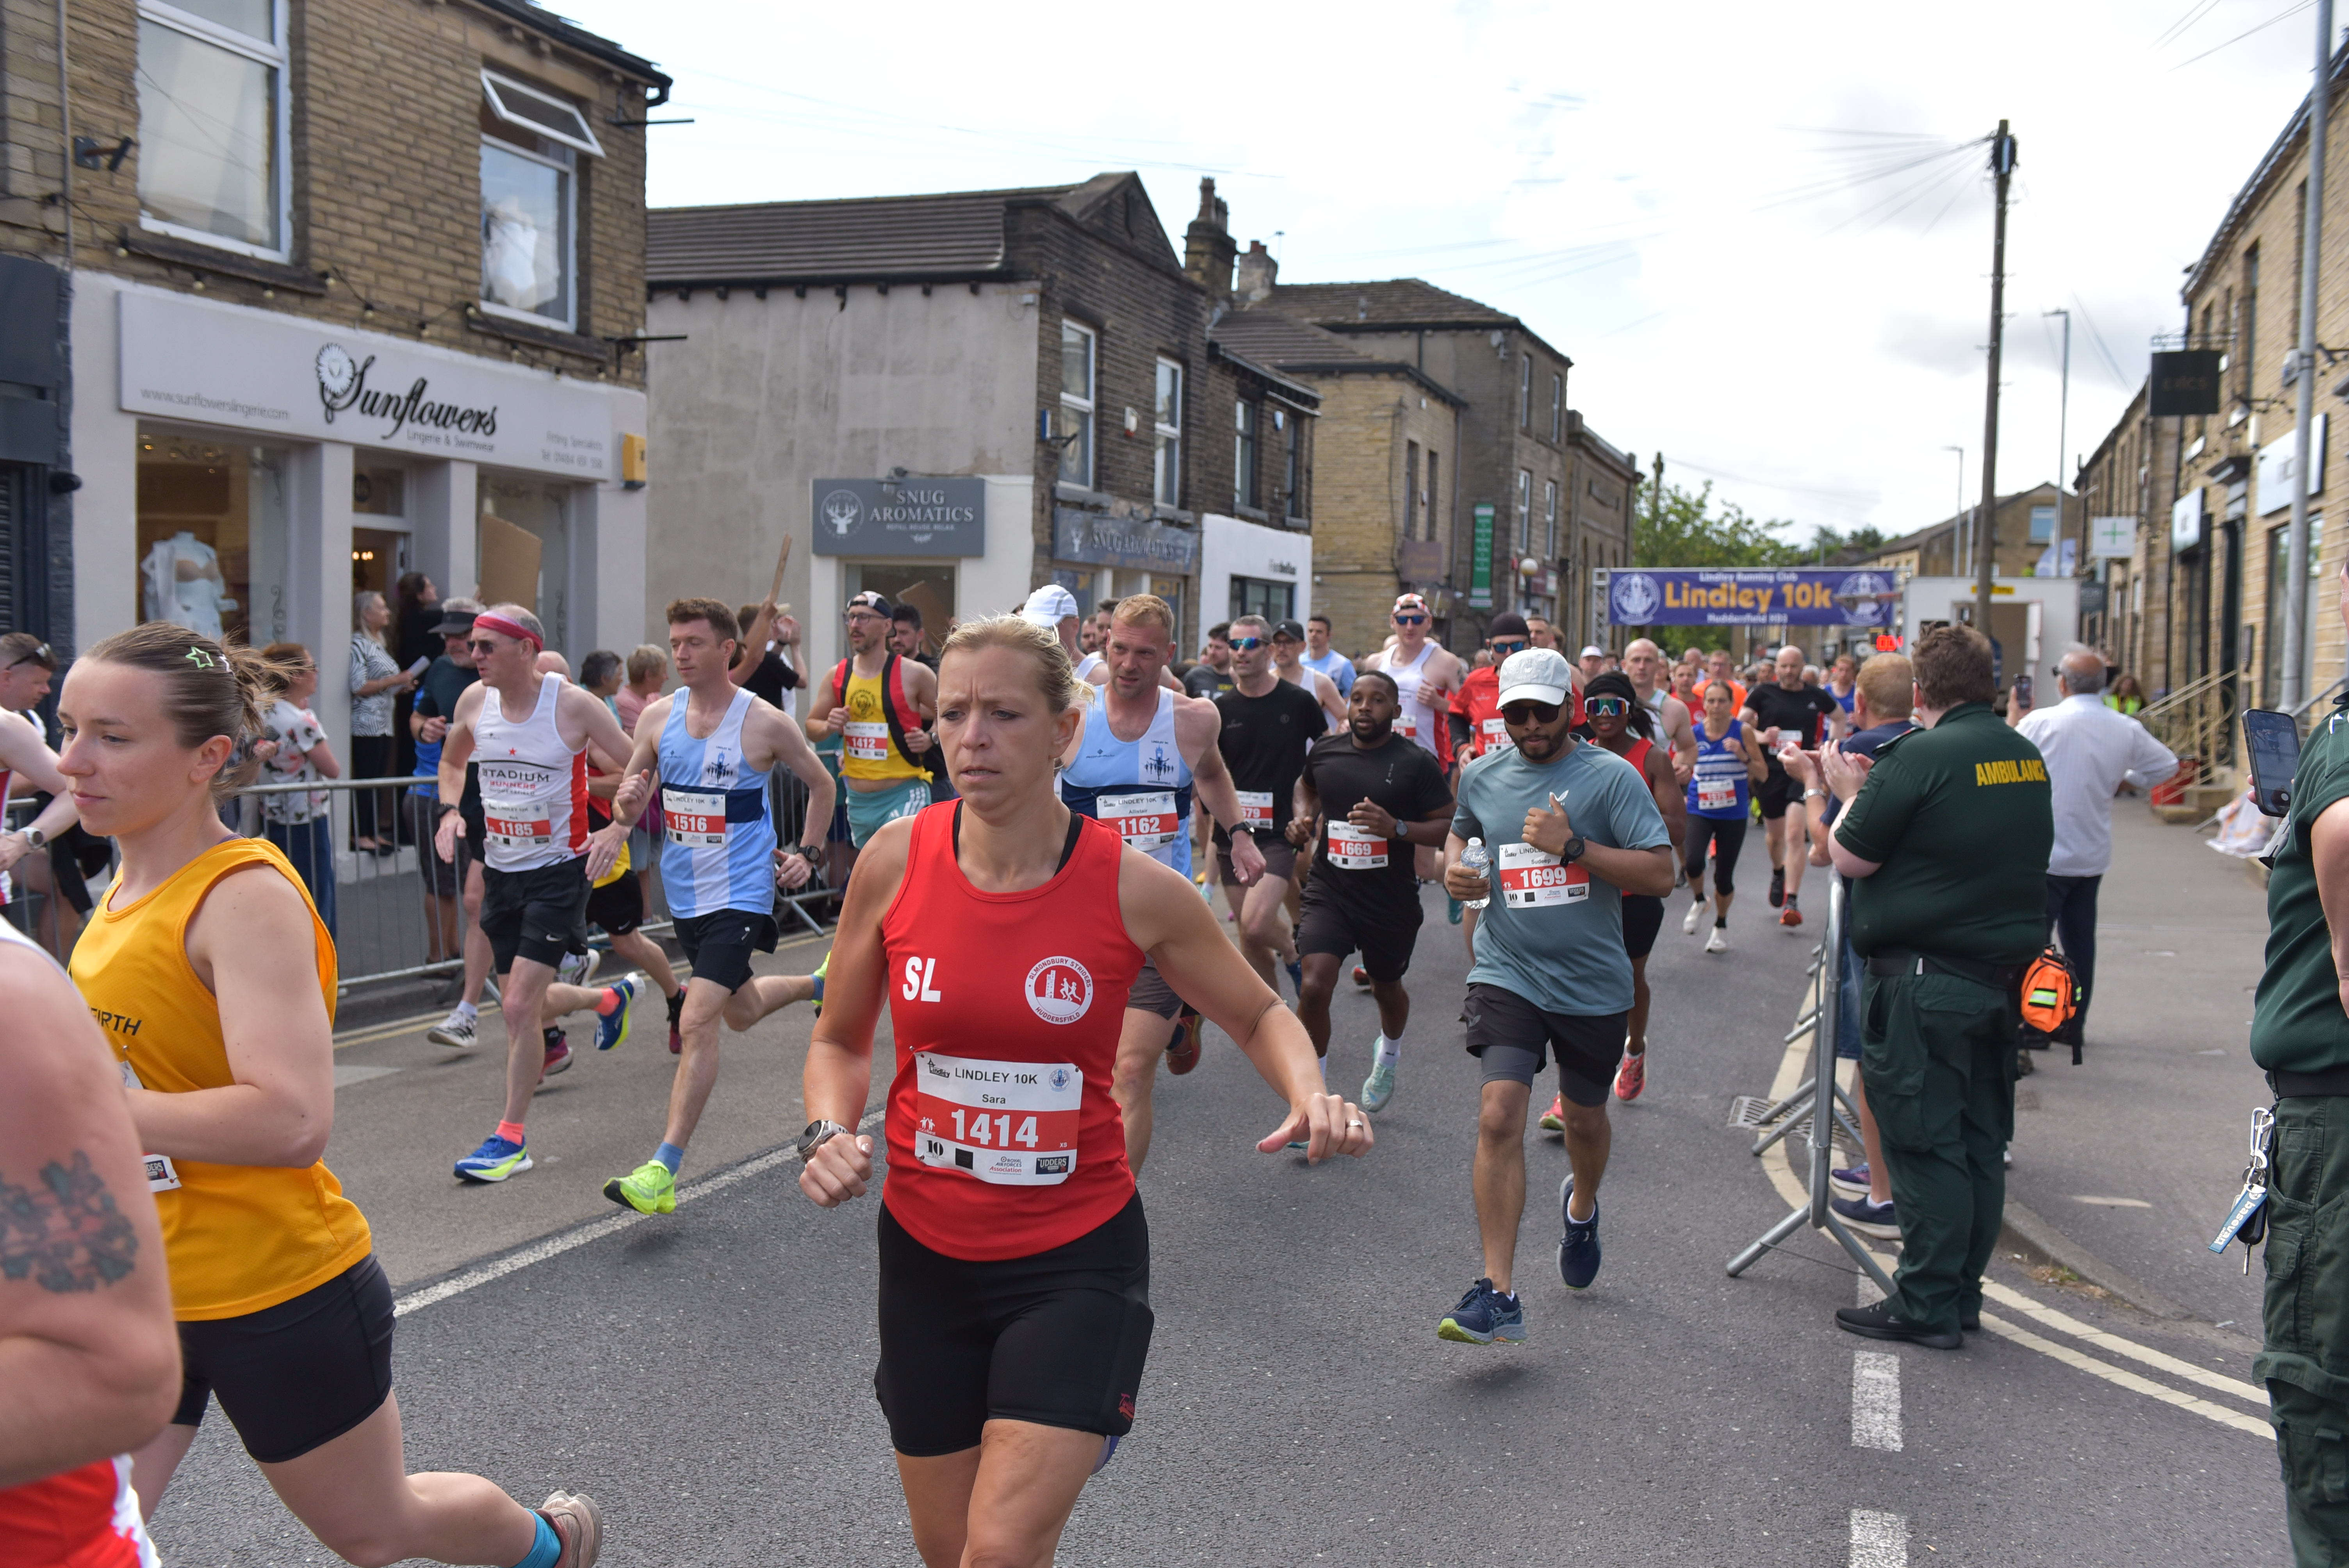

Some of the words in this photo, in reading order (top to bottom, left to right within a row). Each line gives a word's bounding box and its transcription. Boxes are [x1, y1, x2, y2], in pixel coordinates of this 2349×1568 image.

[140, 388, 289, 420] www.sunflowerslingerie.com
[318, 355, 498, 440] Sunflowers
[407, 429, 441, 445] Lingerie
[444, 434, 450, 447] &
[454, 437, 494, 453] Swimwear
[896, 490, 945, 505] SNUG
[870, 506, 974, 522] AROMATICS
[1699, 572, 1735, 583] Lindley
[1736, 572, 1775, 583] Running
[1776, 572, 1798, 582] Club
[1665, 581, 1774, 614] Lindley
[1782, 581, 1832, 609] 10k
[1707, 613, 1768, 624] Huddersfield
[852, 737, 876, 749] 1412
[482, 768, 549, 782] STADIUM
[1975, 759, 2047, 786] AMBULANCE
[490, 780, 536, 789] RUNNERS
[499, 821, 534, 837] 1185
[673, 814, 708, 832] 1516
[1118, 816, 1160, 835] 1162
[1340, 841, 1372, 856] 1669
[1520, 867, 1567, 888] 1699
[1508, 893, 1518, 901] 10
[902, 956, 941, 1003] SL
[1029, 958, 1069, 980] ALMONDBURY
[1070, 961, 1091, 988] STRIDERS
[1035, 1007, 1080, 1023] HUDDERSFIELD
[929, 1065, 950, 1078] Lindley
[955, 1067, 1010, 1083] LINDLEY
[1014, 1074, 1038, 1085] 10K
[982, 1094, 1006, 1104] Sara
[951, 1108, 1039, 1148] 1414
[927, 1140, 944, 1156] 10
[1039, 1158, 1067, 1168] UDDERS
[2217, 1201, 2256, 1245] basevan
